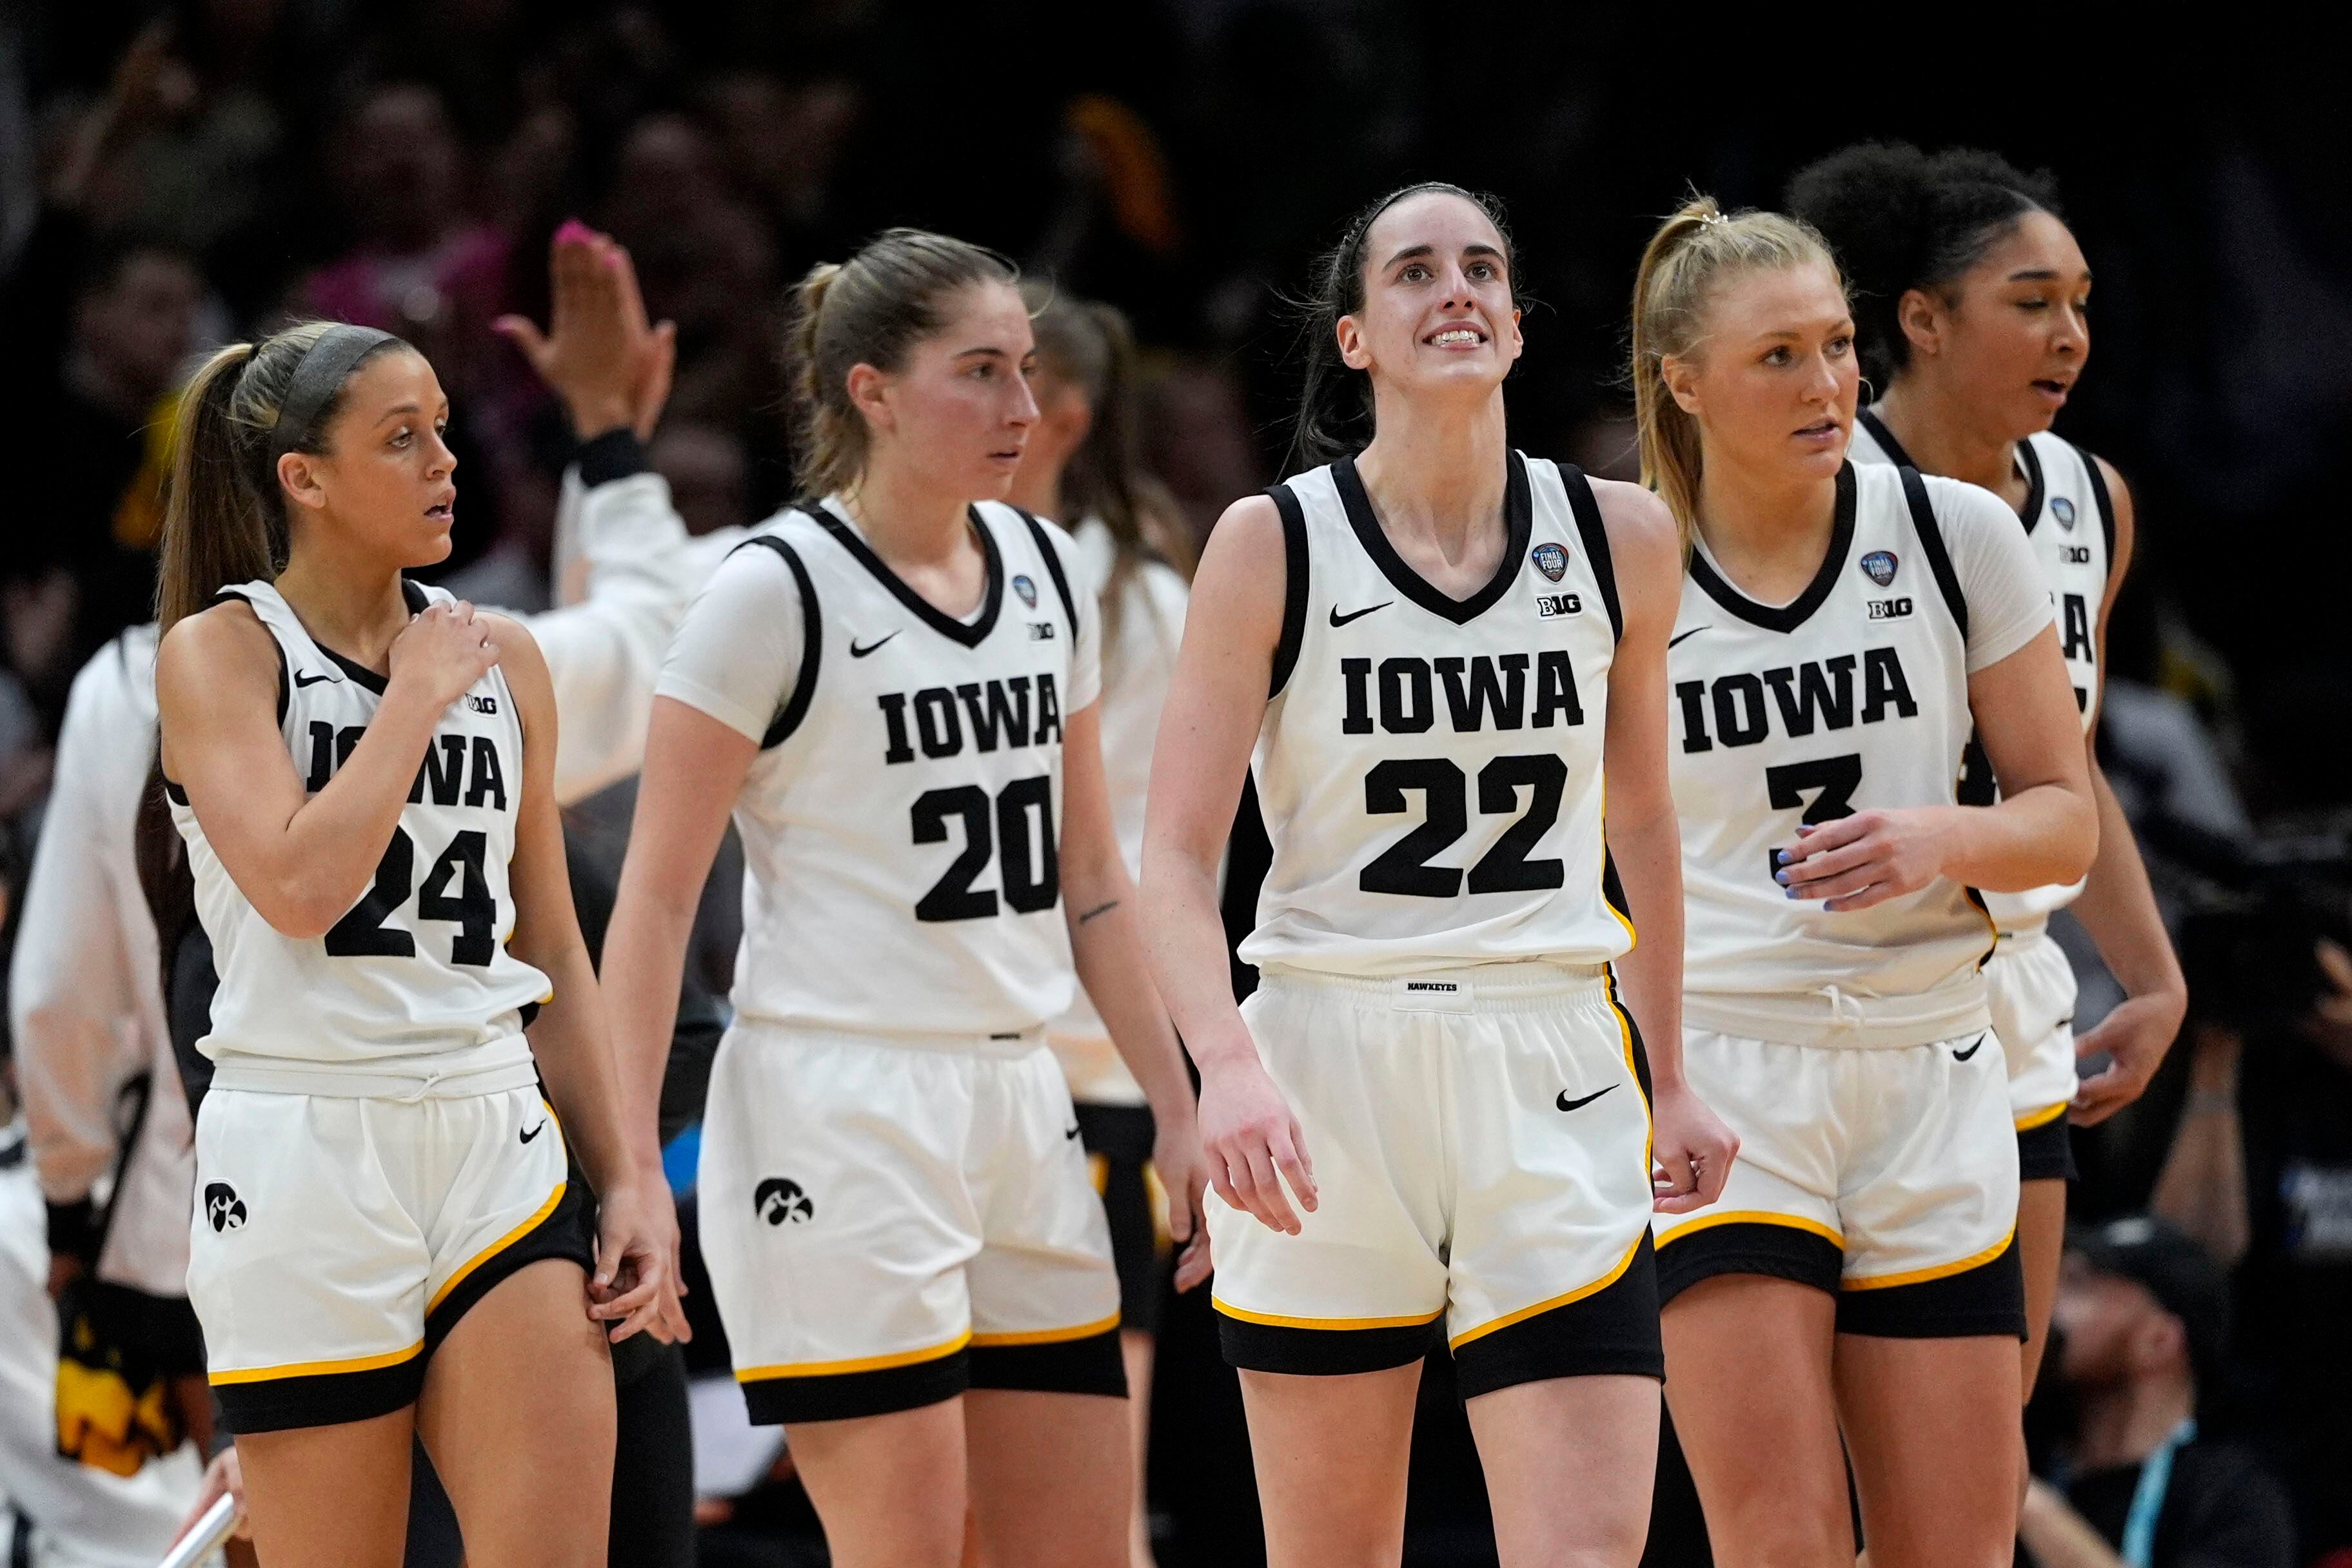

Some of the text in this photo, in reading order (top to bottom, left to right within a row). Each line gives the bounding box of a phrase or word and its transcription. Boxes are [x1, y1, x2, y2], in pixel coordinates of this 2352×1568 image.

[1540, 551, 1561, 562] FINAL
[1542, 559, 1563, 569] FOUR
[878, 673, 1063, 765] IOWA
[1341, 650, 1584, 734] IOWA
[1675, 647, 1918, 753] IOWA
[911, 776, 1060, 922] 20
[1359, 754, 1568, 898] 22
[1766, 753, 1863, 888] 3
[324, 825, 497, 967] 24
[1407, 983, 1457, 992] HAWKEYES
